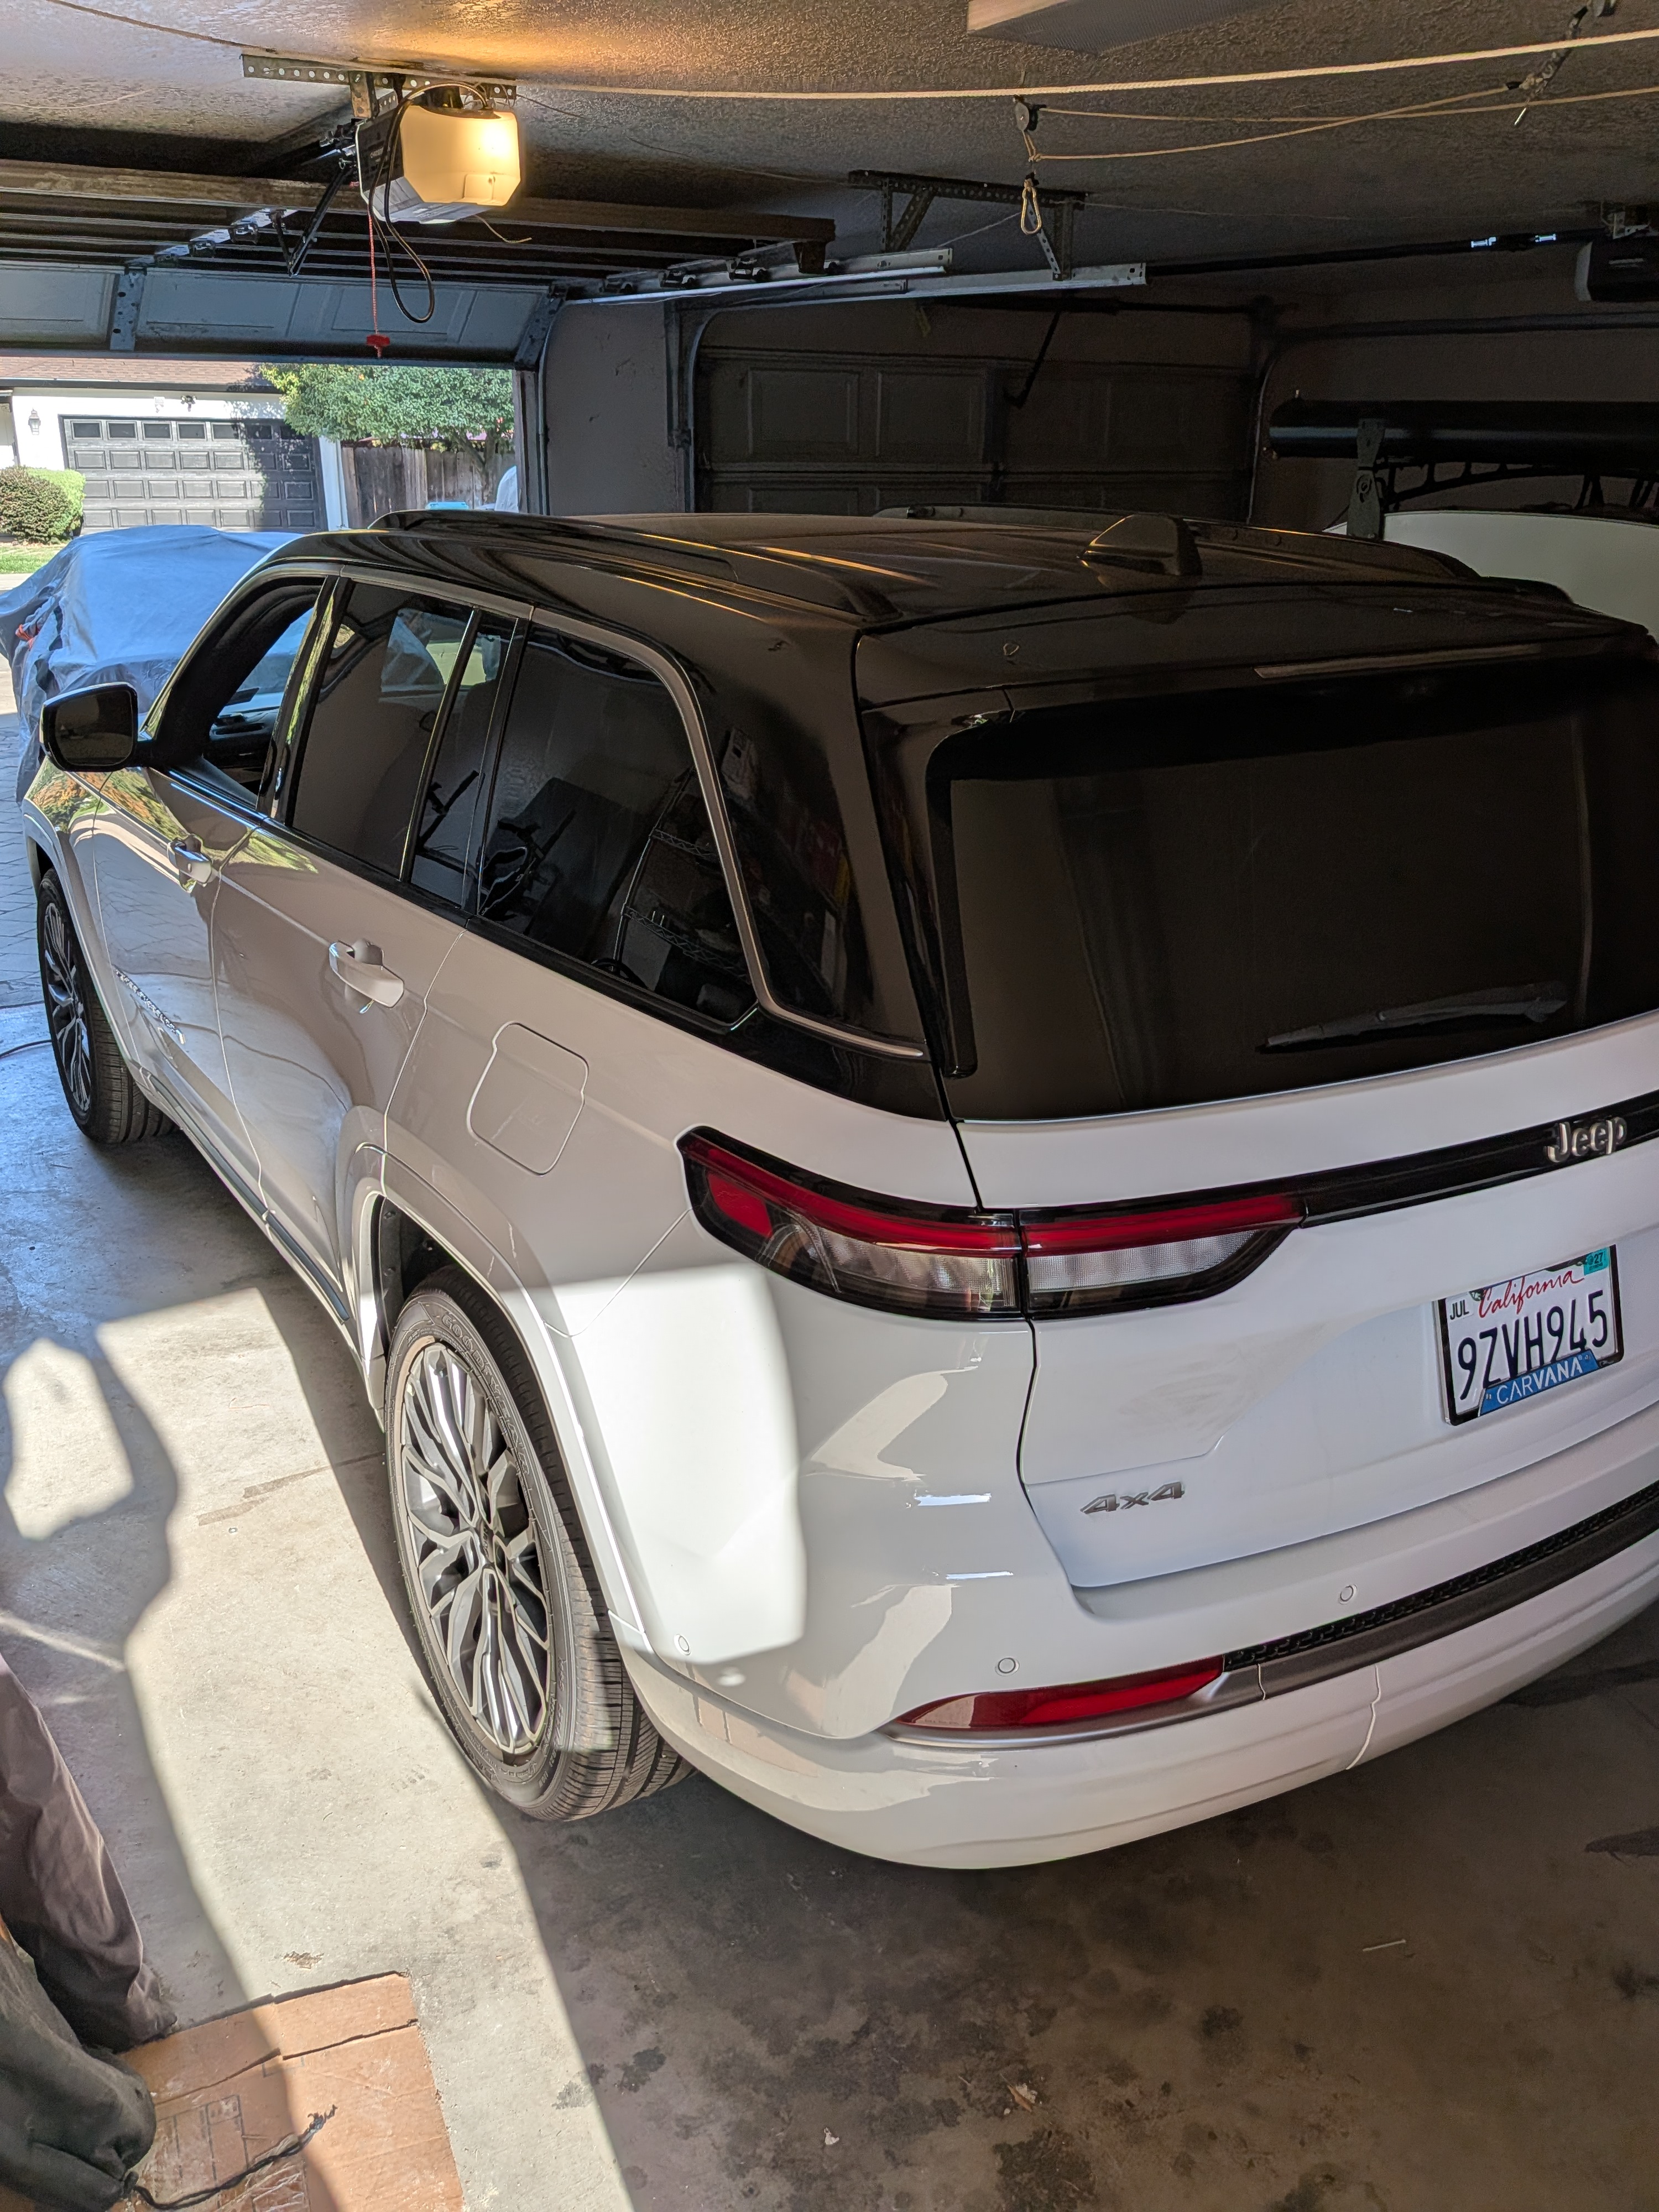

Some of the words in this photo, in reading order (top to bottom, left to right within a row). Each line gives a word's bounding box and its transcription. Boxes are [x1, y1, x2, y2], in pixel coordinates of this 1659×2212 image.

[1543, 1117, 1627, 1163] Jeep
[1594, 1251, 1603, 1264] 27
[1449, 1299, 1469, 1320] JUL
[1478, 1271, 1584, 1317] California
[1458, 1290, 1608, 1400] 9ZVH945
[1496, 1357, 1583, 1404] CARVANA
[1080, 1481, 1185, 1514] 4x4
